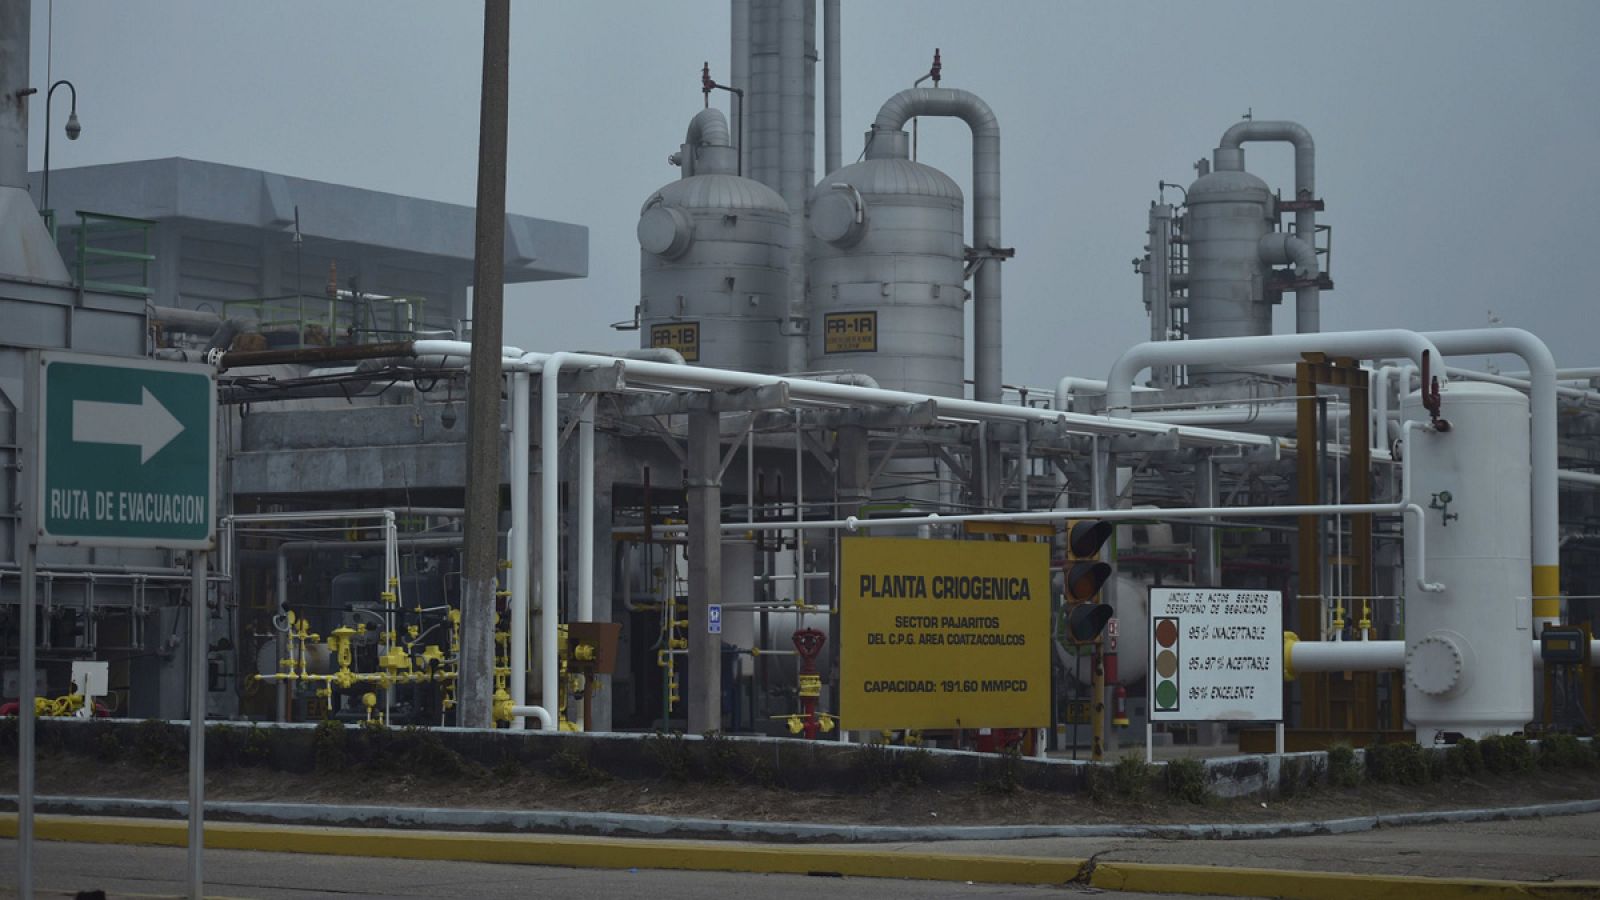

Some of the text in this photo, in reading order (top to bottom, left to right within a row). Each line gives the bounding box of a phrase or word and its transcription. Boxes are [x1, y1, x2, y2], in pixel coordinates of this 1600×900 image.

[827, 318, 872, 334] FA-1A
[51, 488, 205, 525] RUTA DE EVACUACION
[859, 574, 1031, 600] PLANTA CRIOGENICA
[895, 616, 1000, 629] SECTOR PAJARITOS
[868, 633, 1025, 645] DEL C.P.G. AREA COATZACOALCOS
[863, 680, 1028, 693] CAPACIDAD: 191.60 MMPCD
[1210, 686, 1256, 700] EXCELENTE
